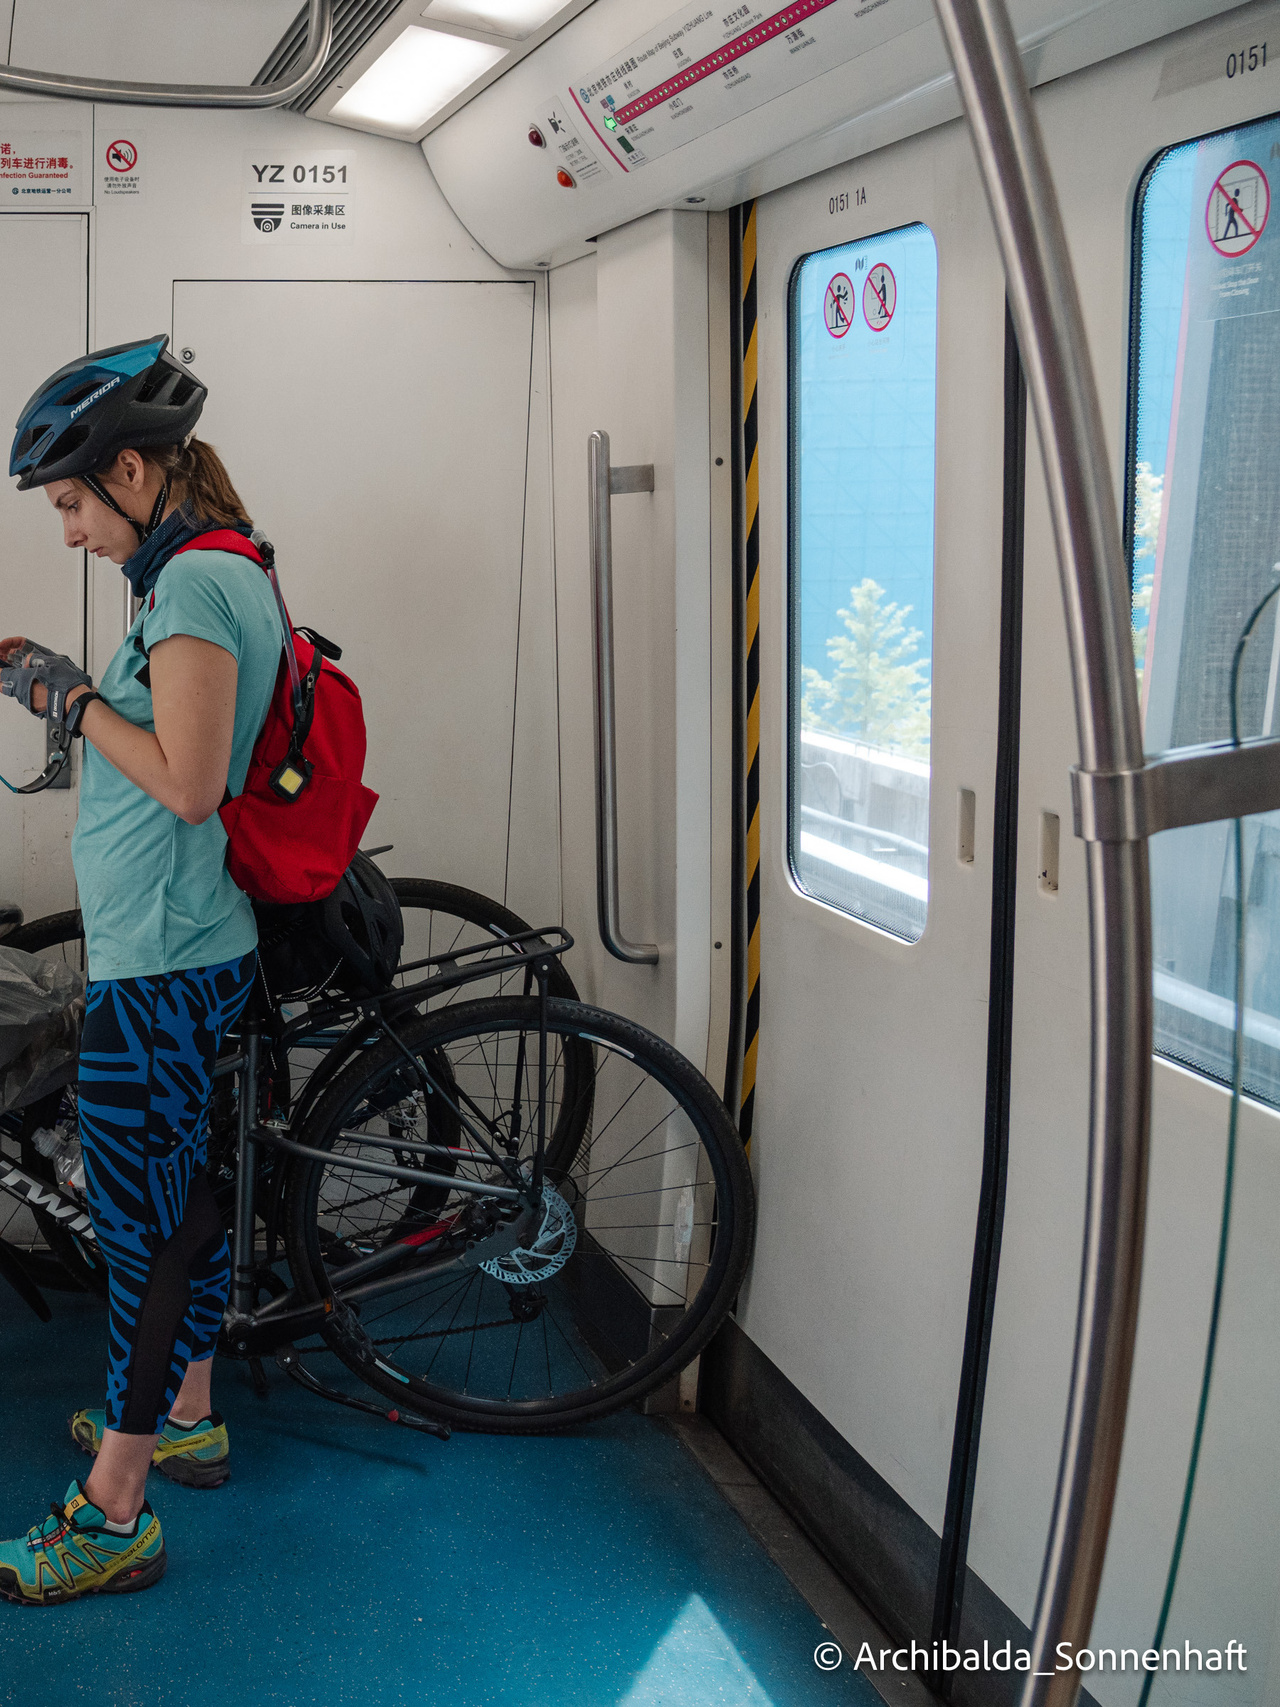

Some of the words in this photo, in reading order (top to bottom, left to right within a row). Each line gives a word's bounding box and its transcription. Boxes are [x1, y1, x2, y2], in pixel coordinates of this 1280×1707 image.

[703, 10, 713, 20] Line
[1226, 41, 1267, 79] 0151
[252, 165, 285, 182] YZ
[293, 165, 347, 183] 0151
[829, 192, 849, 214] 0151
[856, 187, 867, 206] 1A
[291, 204, 345, 216] 图像采集区
[331, 222, 346, 230] Use
[70, 376, 120, 419] MERIDA
